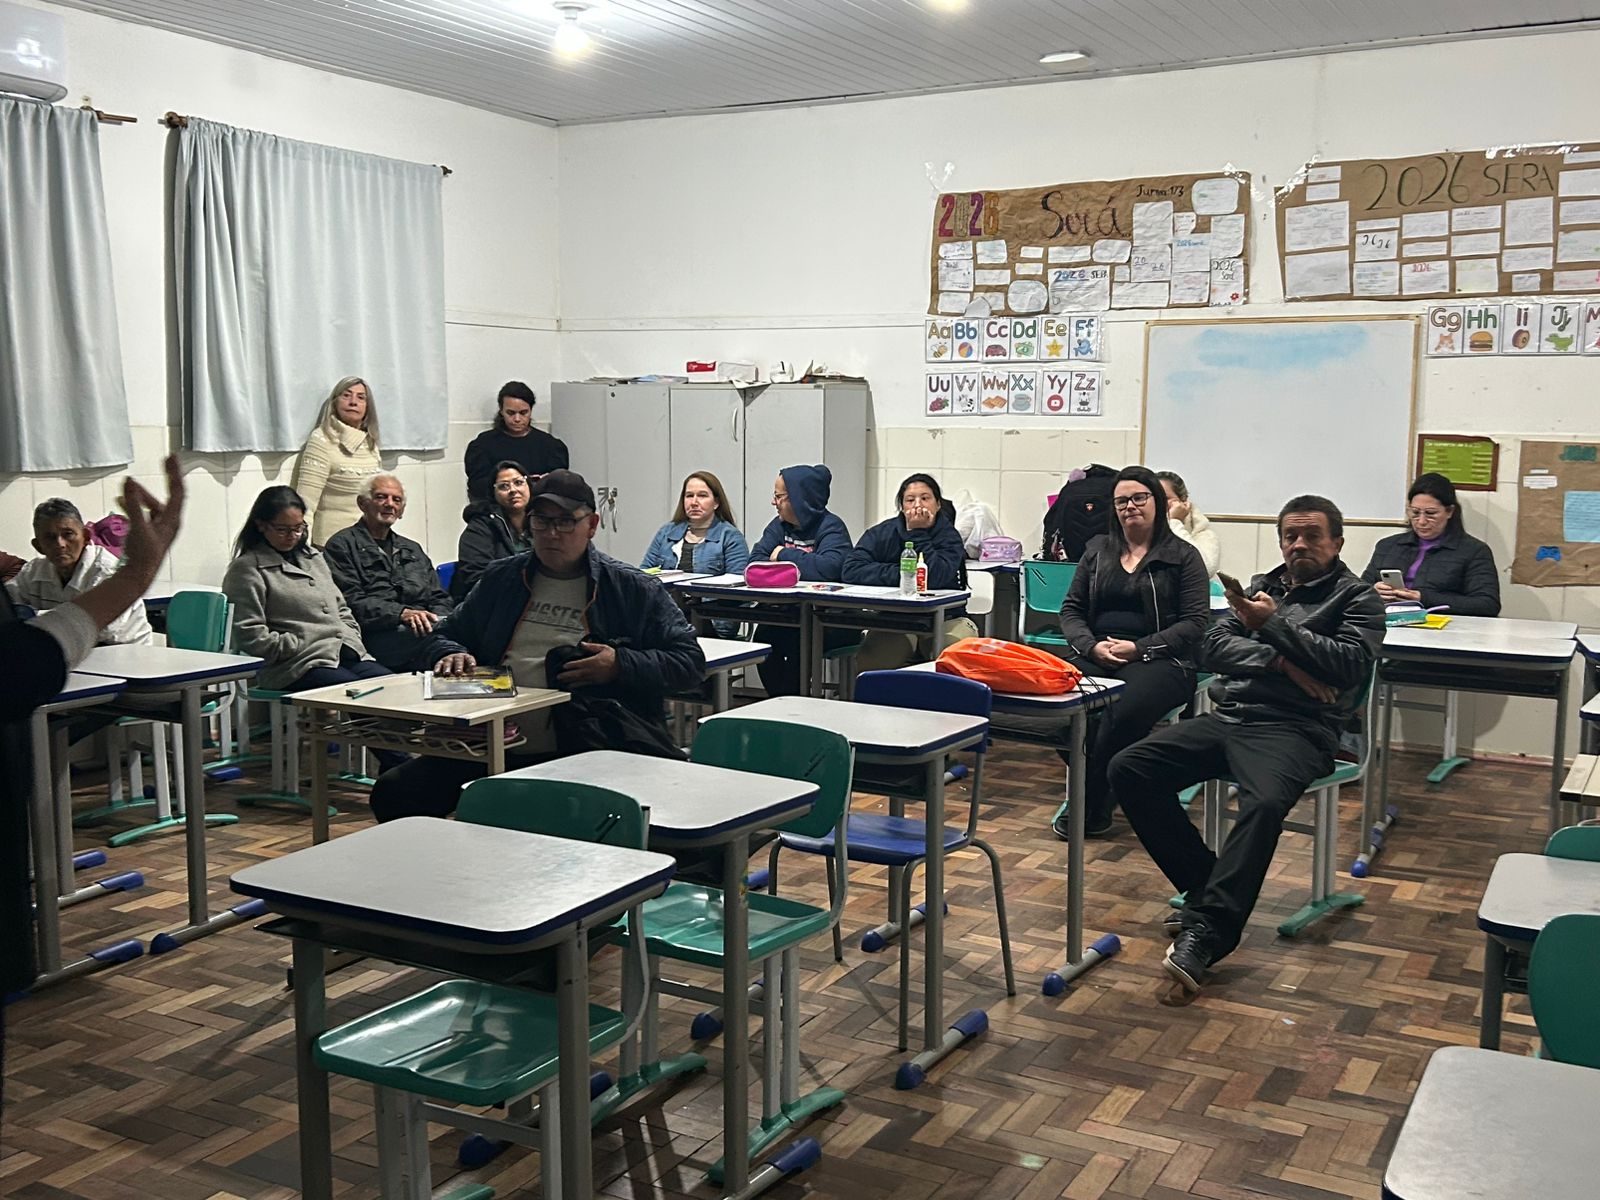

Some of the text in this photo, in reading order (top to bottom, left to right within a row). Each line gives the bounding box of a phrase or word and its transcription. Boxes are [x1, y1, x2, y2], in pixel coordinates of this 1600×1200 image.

[1361, 155, 1471, 211] 2026
[938, 191, 1000, 237] 2026
[927, 318, 1095, 339] Aa Bb Cc Dd Ee Ff
[1430, 307, 1462, 332] Gg
[1466, 307, 1498, 329] Hh
[1516, 307, 1529, 327] Ii
[1551, 305, 1572, 332] Jj
[928, 373, 1096, 394] Uu Vv Ww Xx Yy Zz
